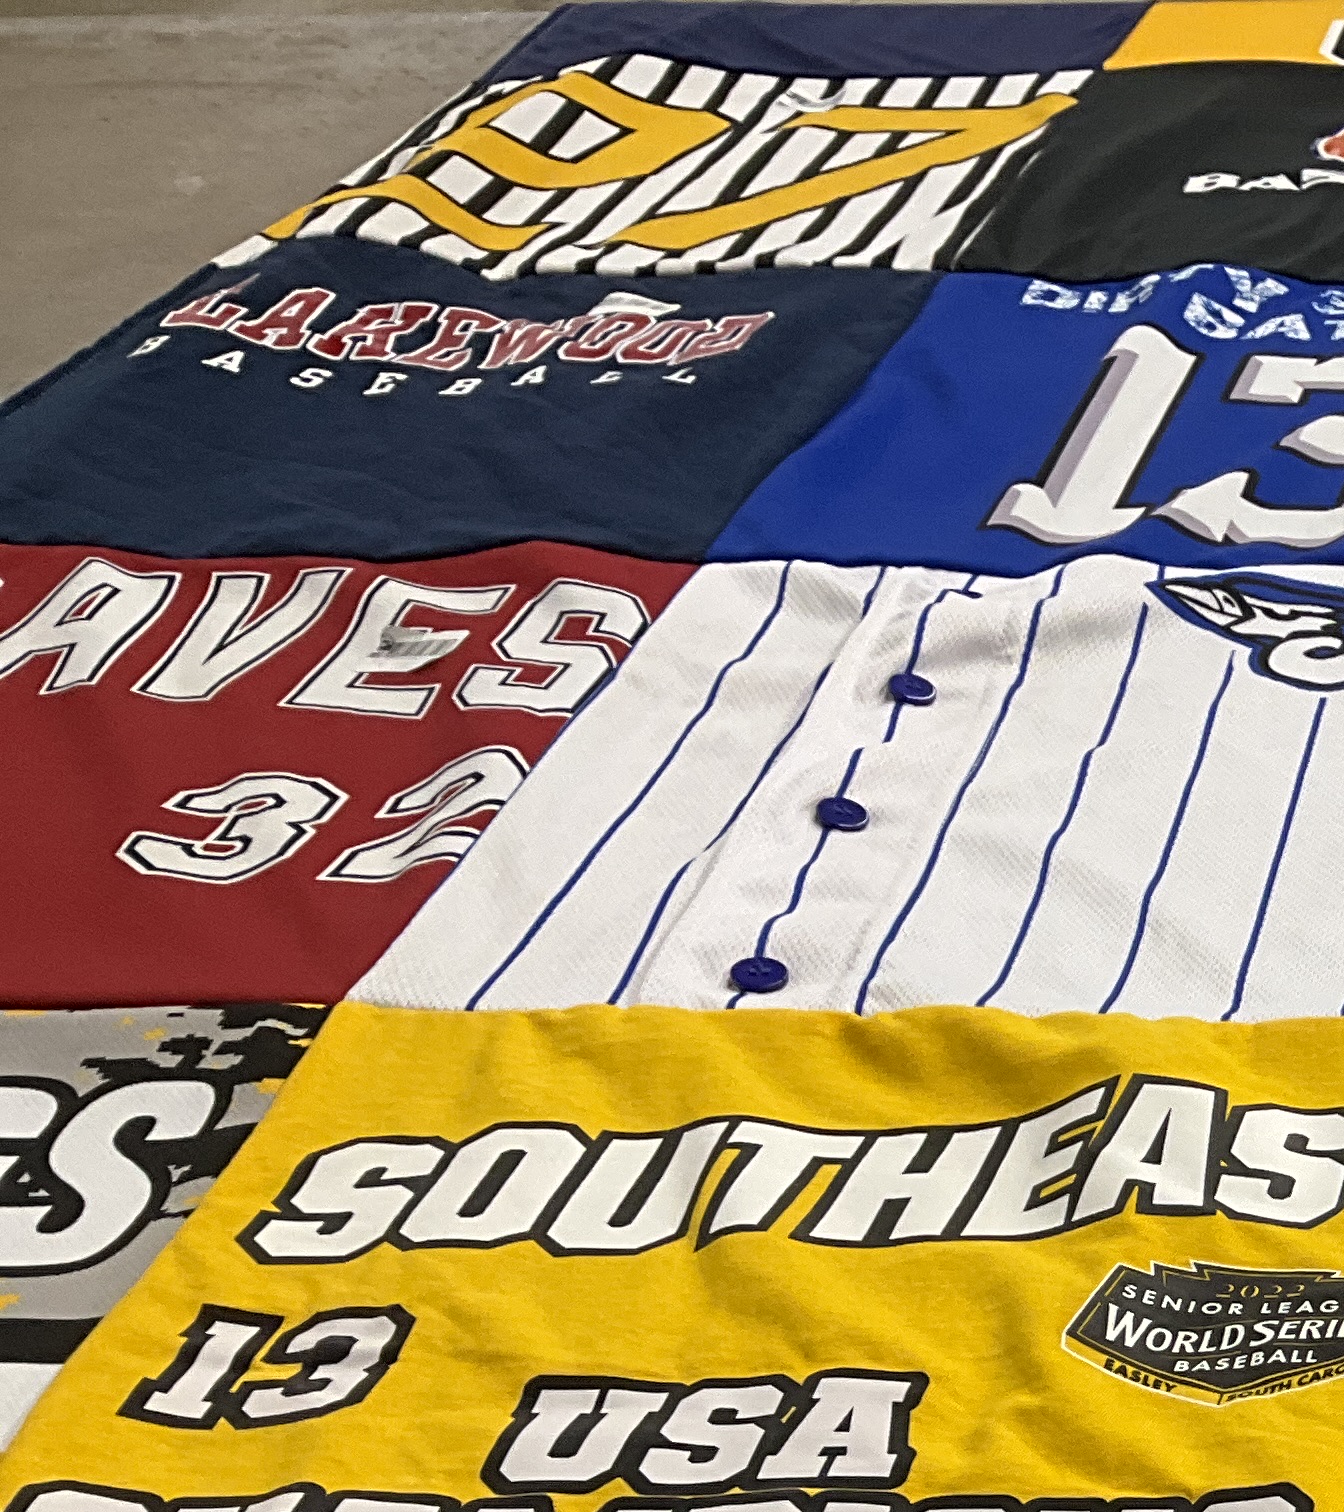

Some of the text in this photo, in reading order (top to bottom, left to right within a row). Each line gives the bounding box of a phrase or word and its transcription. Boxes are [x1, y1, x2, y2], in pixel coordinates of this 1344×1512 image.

[160, 274, 776, 370] LAKEWOOD
[0, 556, 653, 719] AVES
[1104, 1302, 1246, 1354] WORLD
[1121, 1283, 1244, 1317] SENIOR
[118, 1302, 416, 1430] 13
[1103, 1357, 1179, 1394] EASLEY
[1226, 1379, 1294, 1402] SOUTH
[1172, 1349, 1319, 1374] BASEBALL
[480, 1366, 930, 1496] USA
